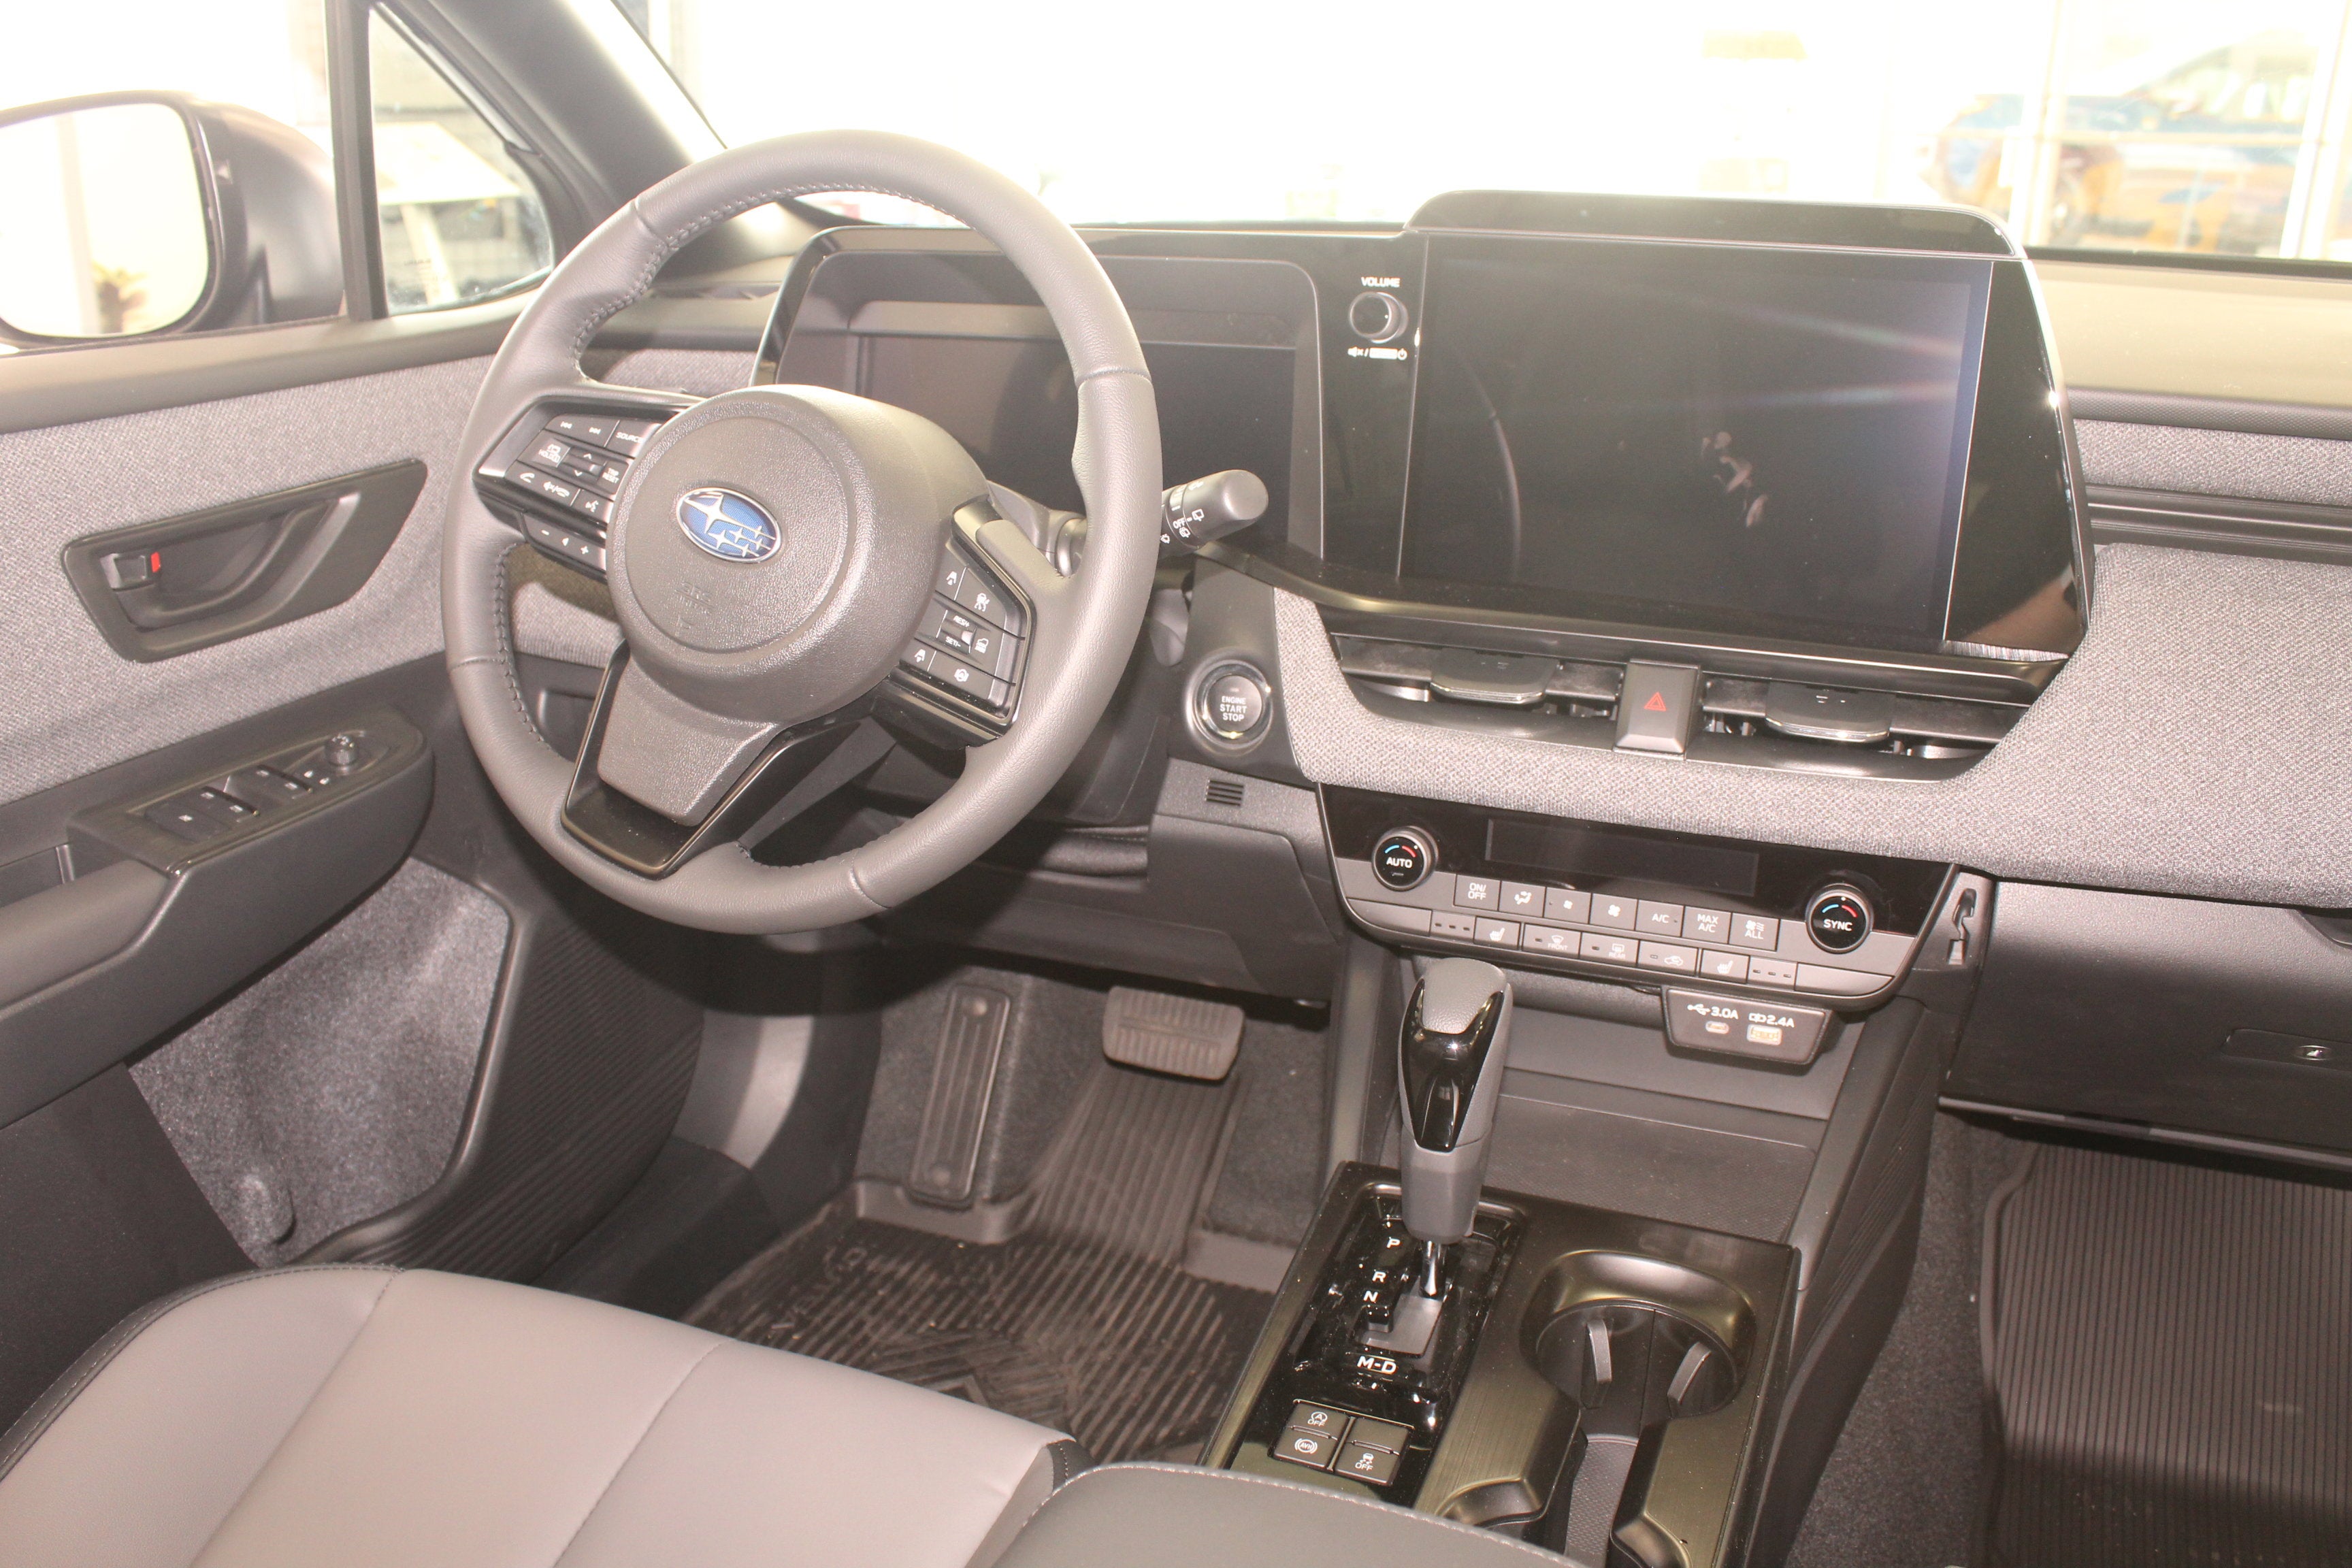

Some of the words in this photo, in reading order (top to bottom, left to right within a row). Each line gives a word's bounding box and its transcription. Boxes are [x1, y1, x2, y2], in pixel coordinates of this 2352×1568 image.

[1361, 276, 1401, 288] VOLUME
[1173, 518, 1186, 529] OFF
[1222, 696, 1246, 704] ENGINE
[1220, 704, 1247, 713] START
[1223, 713, 1244, 721] STOP
[1386, 857, 1413, 868] AUTO
[1469, 883, 1486, 892] ON/
[1468, 890, 1486, 900] OFF
[1652, 913, 1669, 924] A/C
[1697, 913, 1718, 924] MAX
[1699, 923, 1716, 933] A/C
[1823, 919, 1852, 931] SYNC
[1745, 930, 1763, 940] ALL
[1548, 943, 1568, 951] FRONT
[1711, 1006, 1739, 1019] 3.0A
[1766, 1014, 1795, 1028] 2.4A
[1387, 1238, 1401, 1248] P
[1372, 1271, 1386, 1283] R
[1363, 1290, 1378, 1303] N
[1357, 1356, 1396, 1375] M-D
[1301, 1442, 1313, 1451] AVH
[1355, 1462, 1373, 1471] OFF
